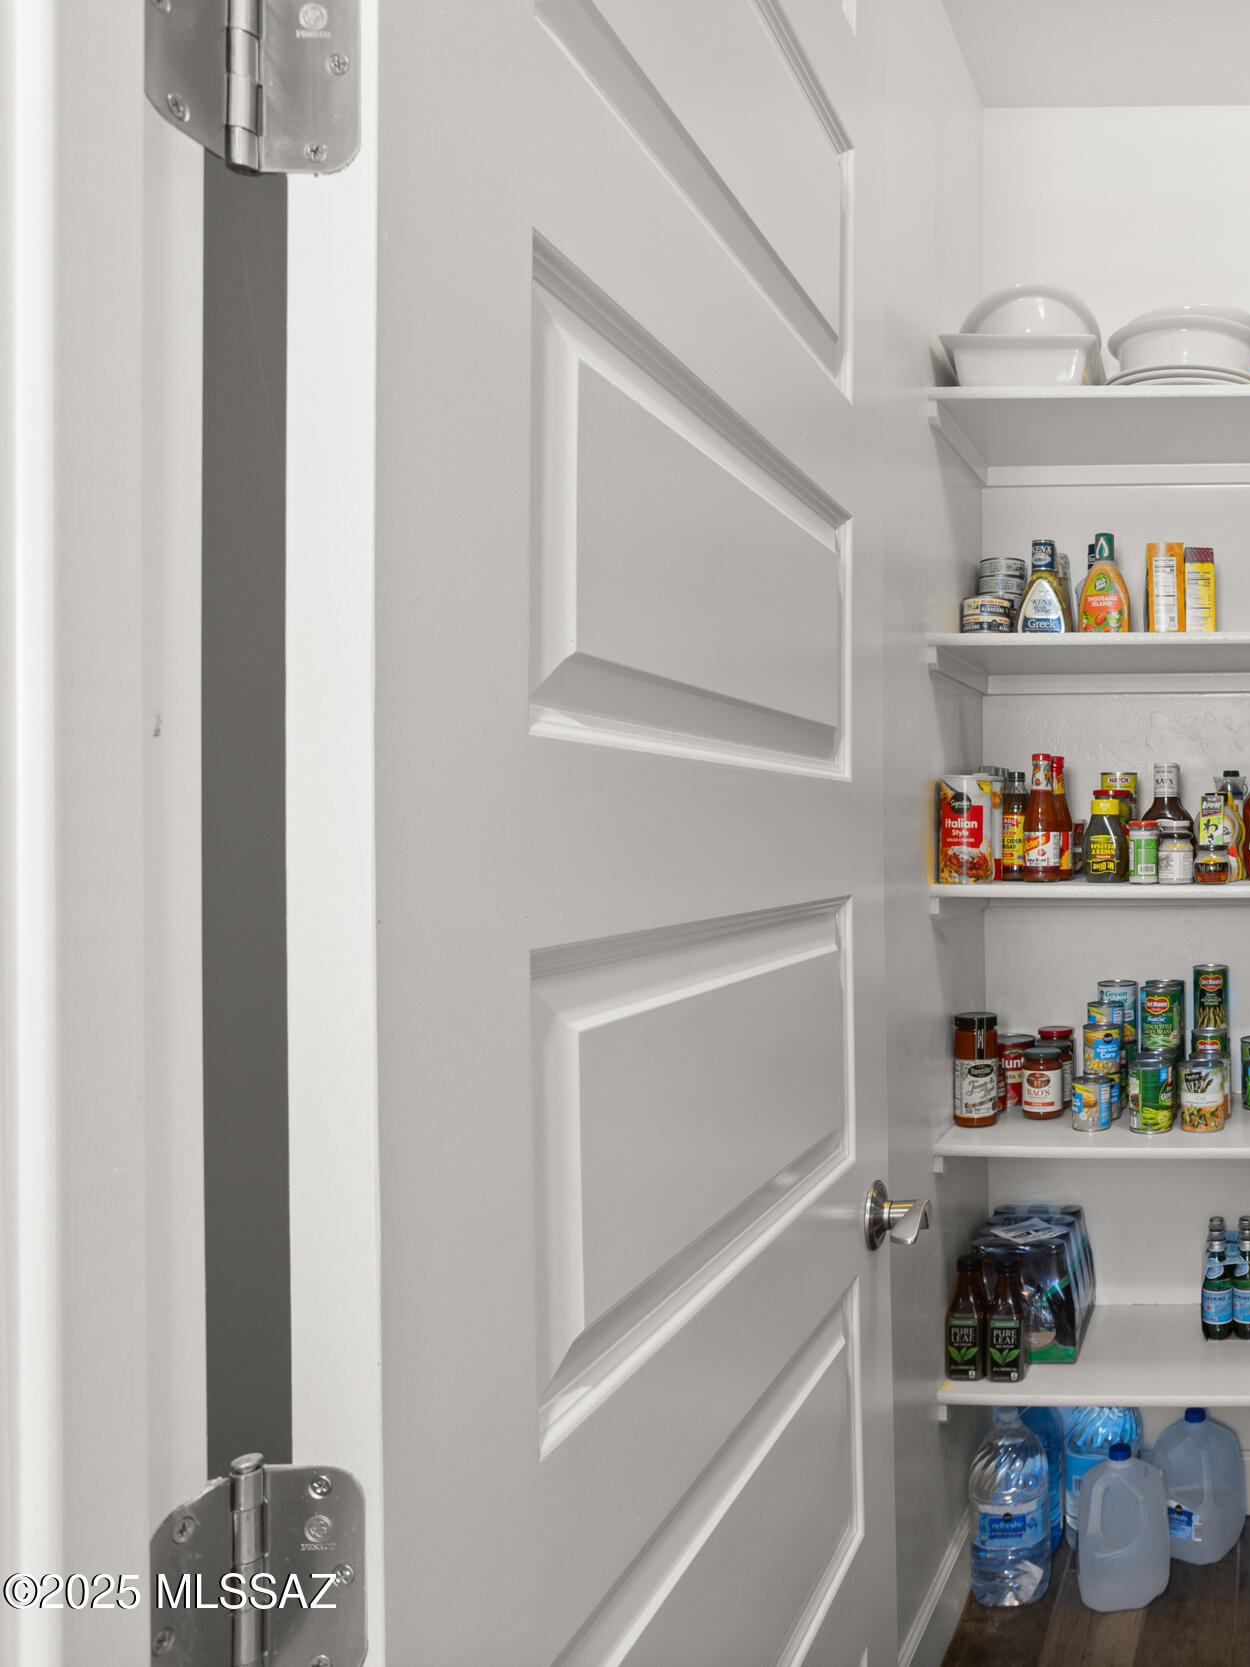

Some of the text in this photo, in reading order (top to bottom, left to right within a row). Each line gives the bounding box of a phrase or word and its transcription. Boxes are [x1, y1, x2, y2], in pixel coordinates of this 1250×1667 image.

[1027, 619, 1056, 629] Greek
[945, 818, 978, 829] Italian
[952, 829, 969, 838] Style
[1026, 1088, 1051, 1096] RAO'S
[951, 1327, 975, 1336] PURE
[993, 1329, 1017, 1338] PURE
[951, 1335, 975, 1343] LEAF
[993, 1337, 1017, 1345] LEAF
[991, 1521, 1024, 1530] refreshe
